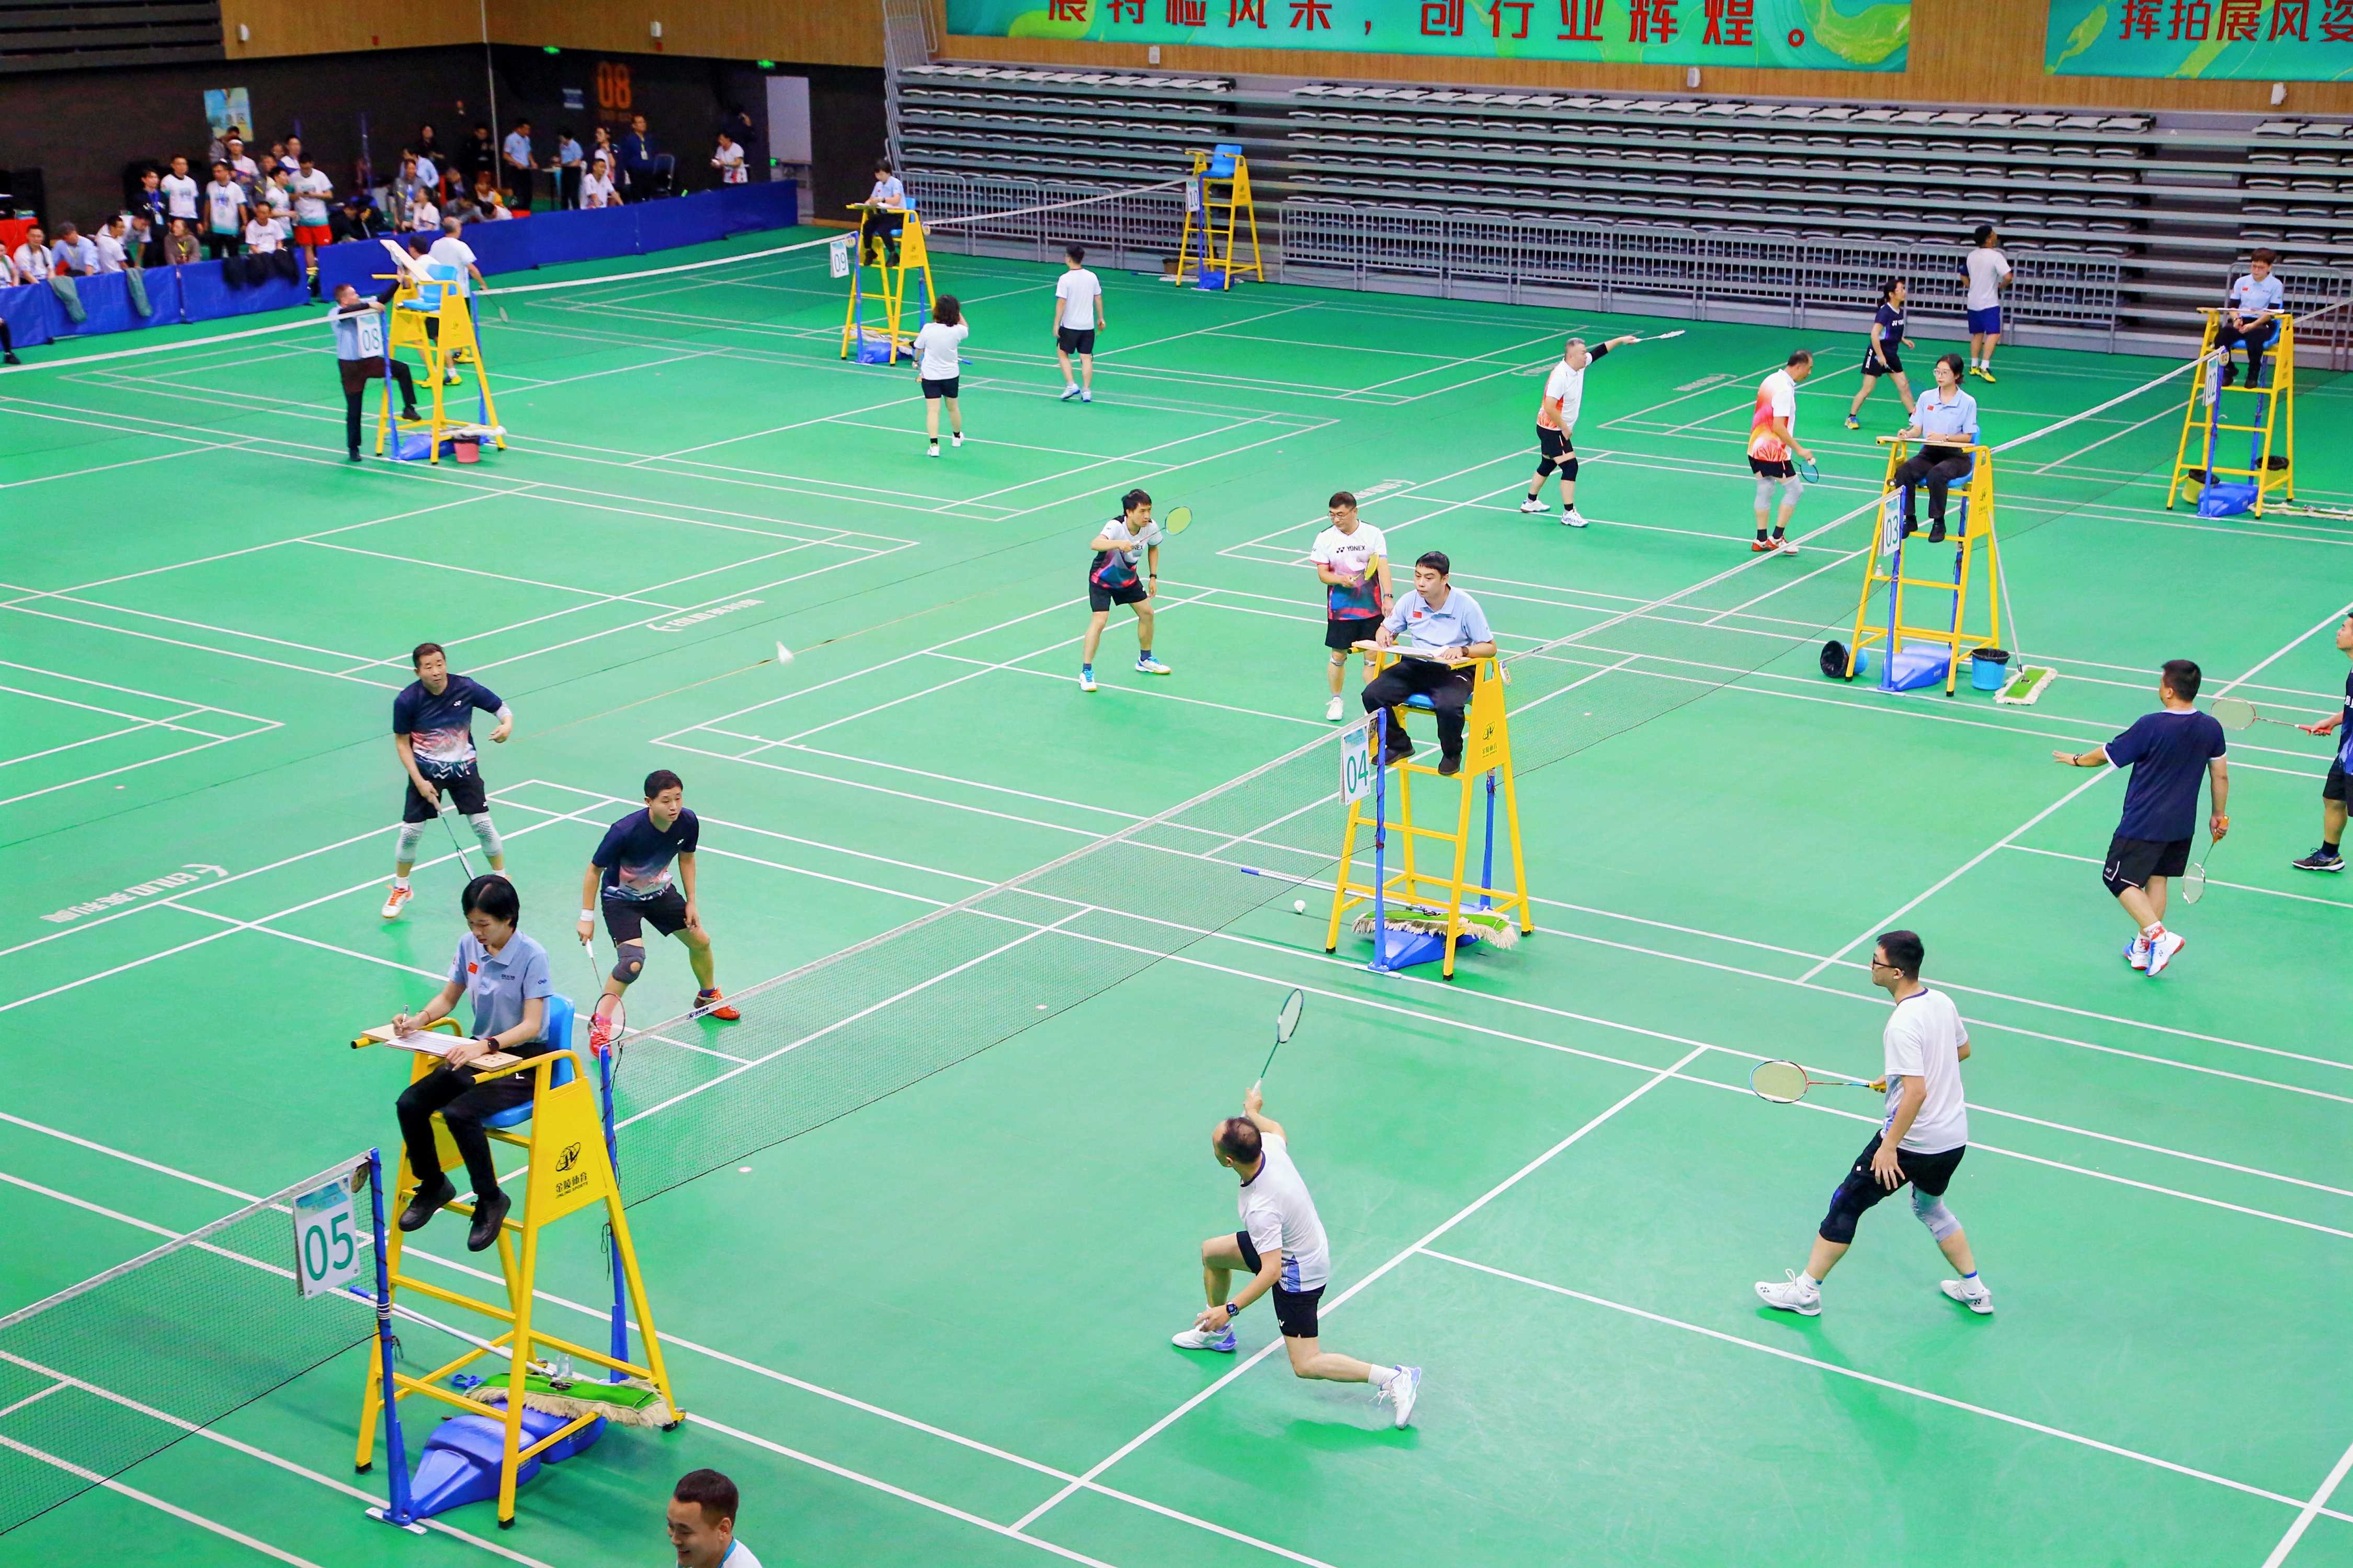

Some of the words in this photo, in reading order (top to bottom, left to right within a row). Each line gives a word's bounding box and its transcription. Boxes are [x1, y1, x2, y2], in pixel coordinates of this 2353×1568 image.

[2119, 0, 2353, 42] 挥拍展风姿
[597, 61, 631, 109] 08
[1189, 190, 1198, 208] 10
[834, 253, 846, 272] 09
[362, 328, 380, 351] 08
[2208, 373, 2216, 398] 02
[1886, 515, 1899, 547] 03
[1347, 749, 1369, 794] 04
[304, 1211, 354, 1281] 05
